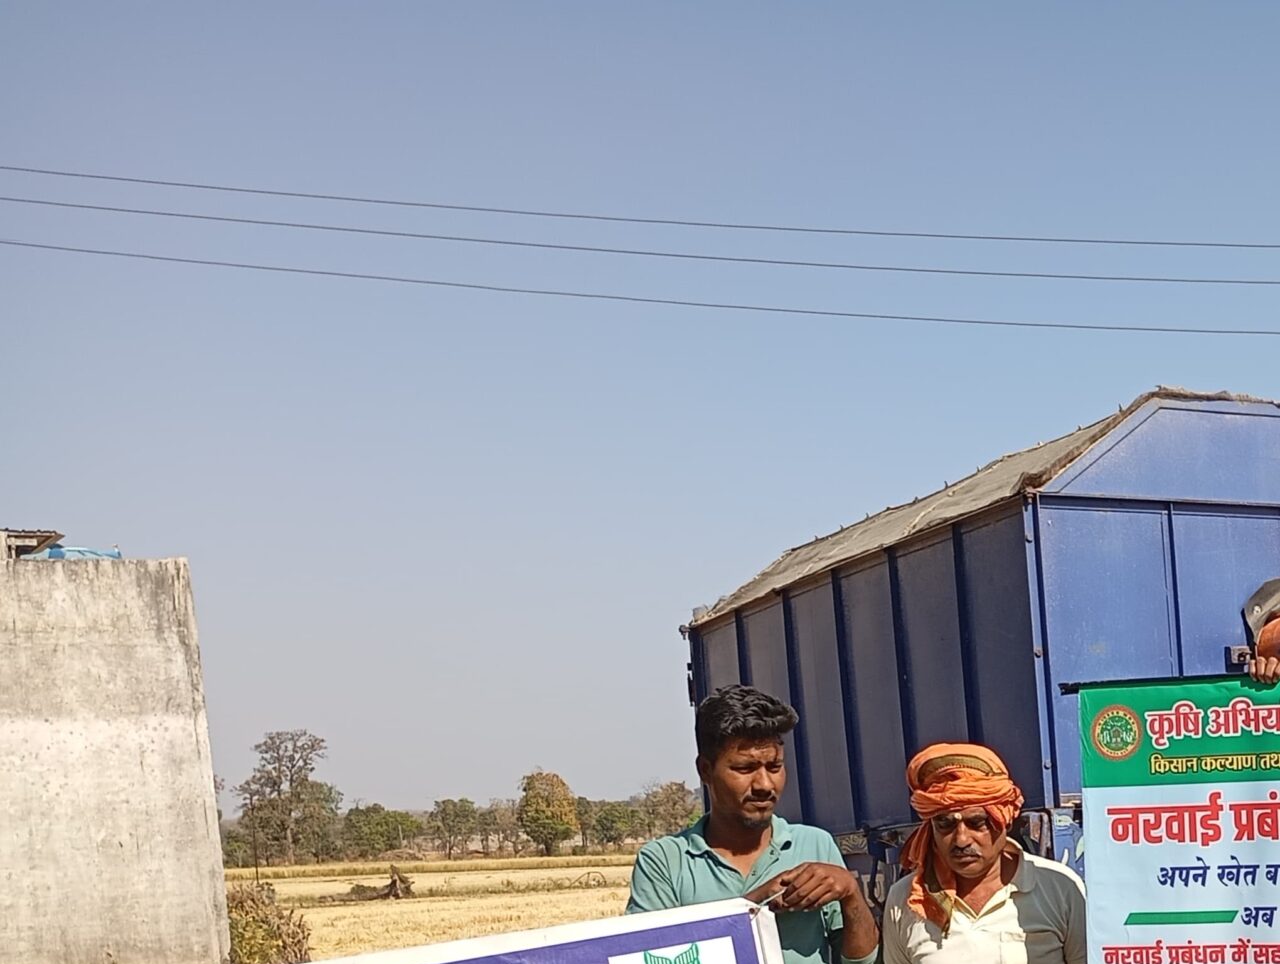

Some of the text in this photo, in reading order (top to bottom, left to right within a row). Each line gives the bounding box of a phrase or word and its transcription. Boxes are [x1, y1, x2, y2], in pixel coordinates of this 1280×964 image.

[1145, 702, 1203, 749] कृषि
[1151, 754, 1197, 773] किसान
[1201, 755, 1256, 771] कल्याण
[1107, 792, 1223, 846] नरवाई
[1157, 856, 1210, 887] अपने
[1217, 855, 1259, 886] खेत
[1241, 906, 1277, 927] अब
[1166, 940, 1227, 964] प्रबंधन
[1230, 938, 1251, 964] में
